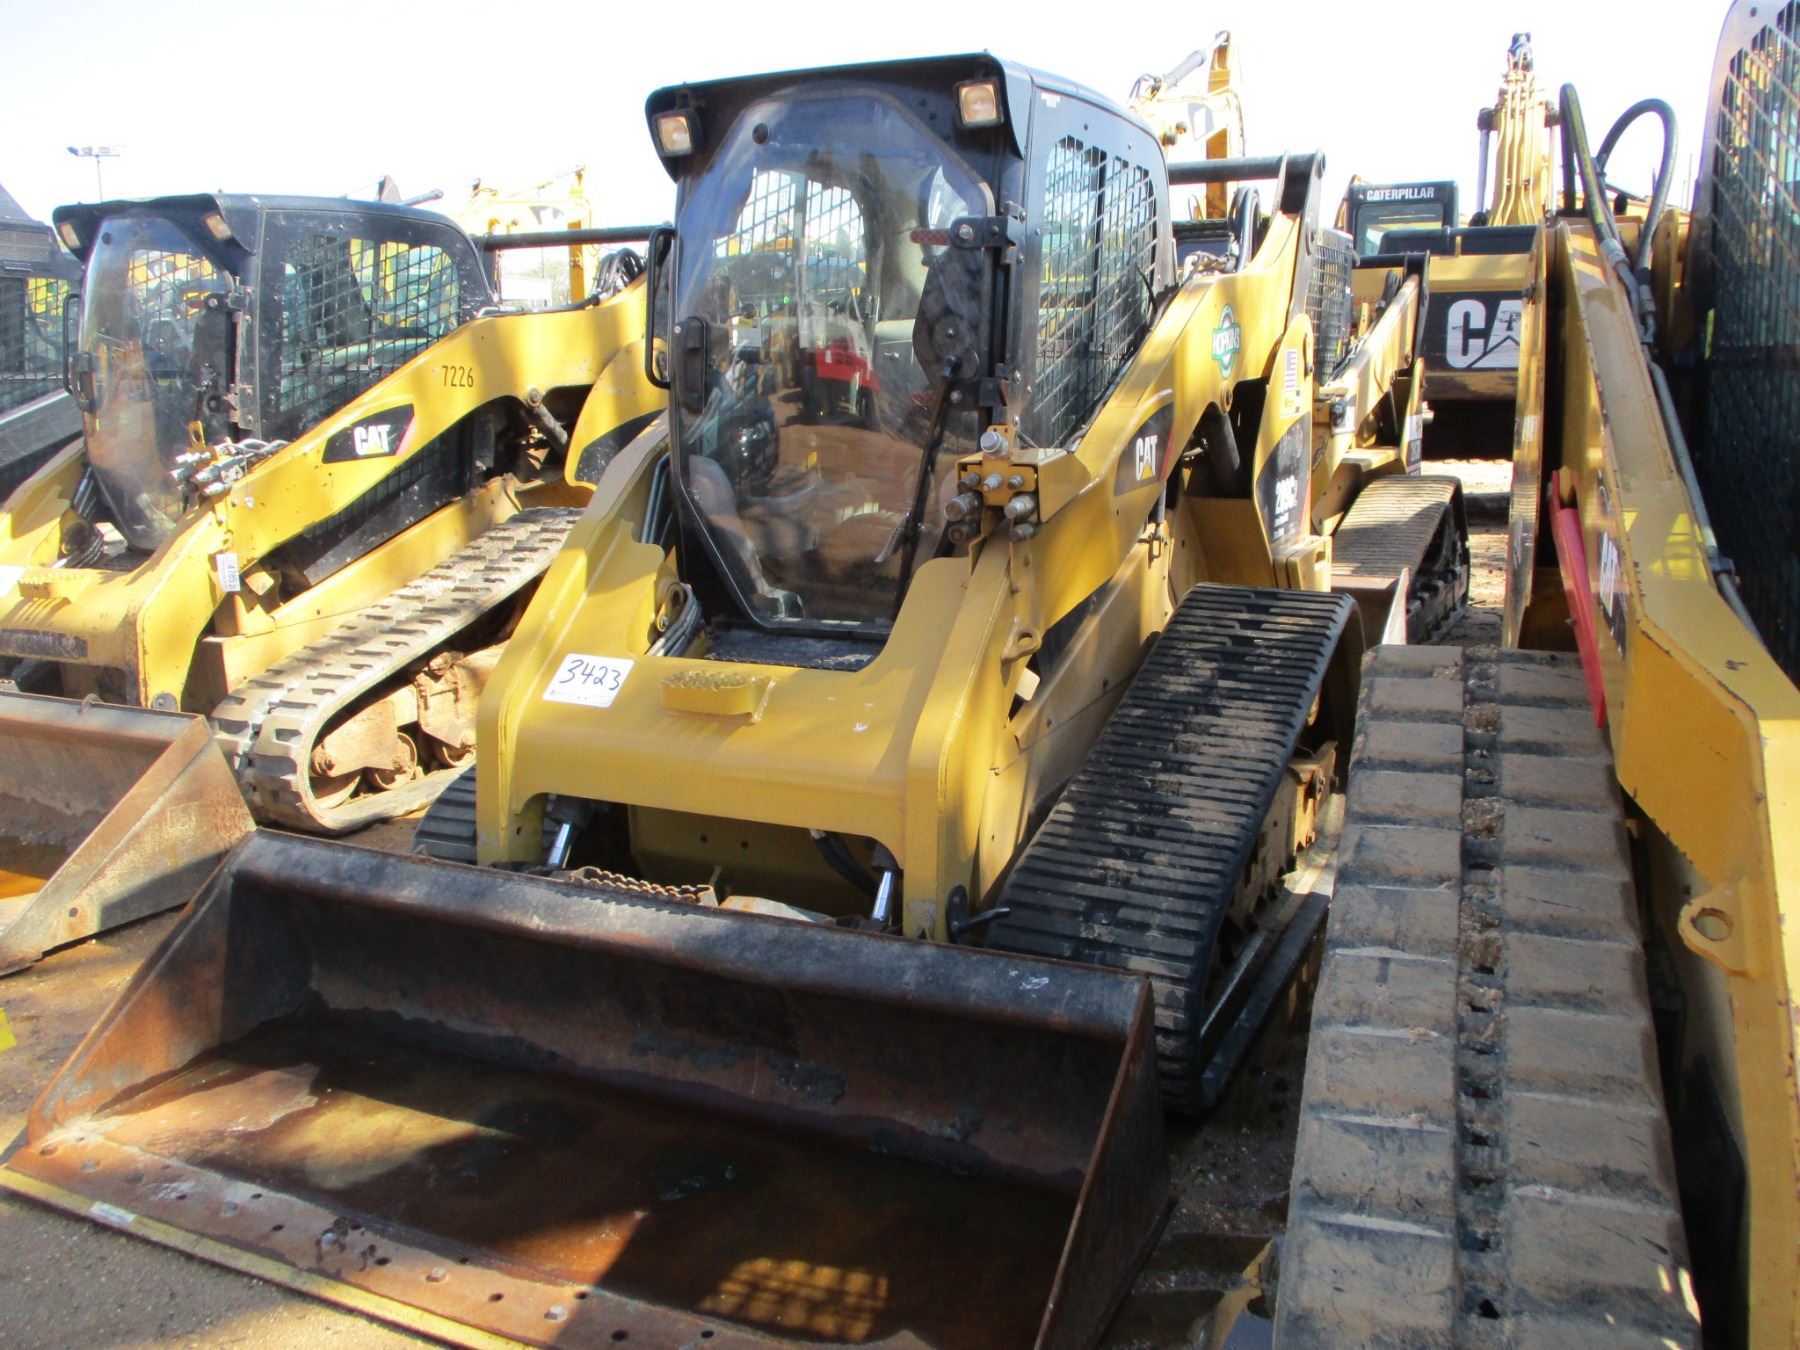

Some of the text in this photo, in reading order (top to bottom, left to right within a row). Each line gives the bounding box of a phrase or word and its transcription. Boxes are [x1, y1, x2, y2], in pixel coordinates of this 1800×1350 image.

[1366, 187, 1435, 201] CATERPILLAR
[1446, 299, 1522, 368] CA
[441, 365, 474, 388] 7226
[354, 424, 391, 456] CAT
[1135, 434, 1158, 481] CAT
[559, 659, 621, 691] 3423
